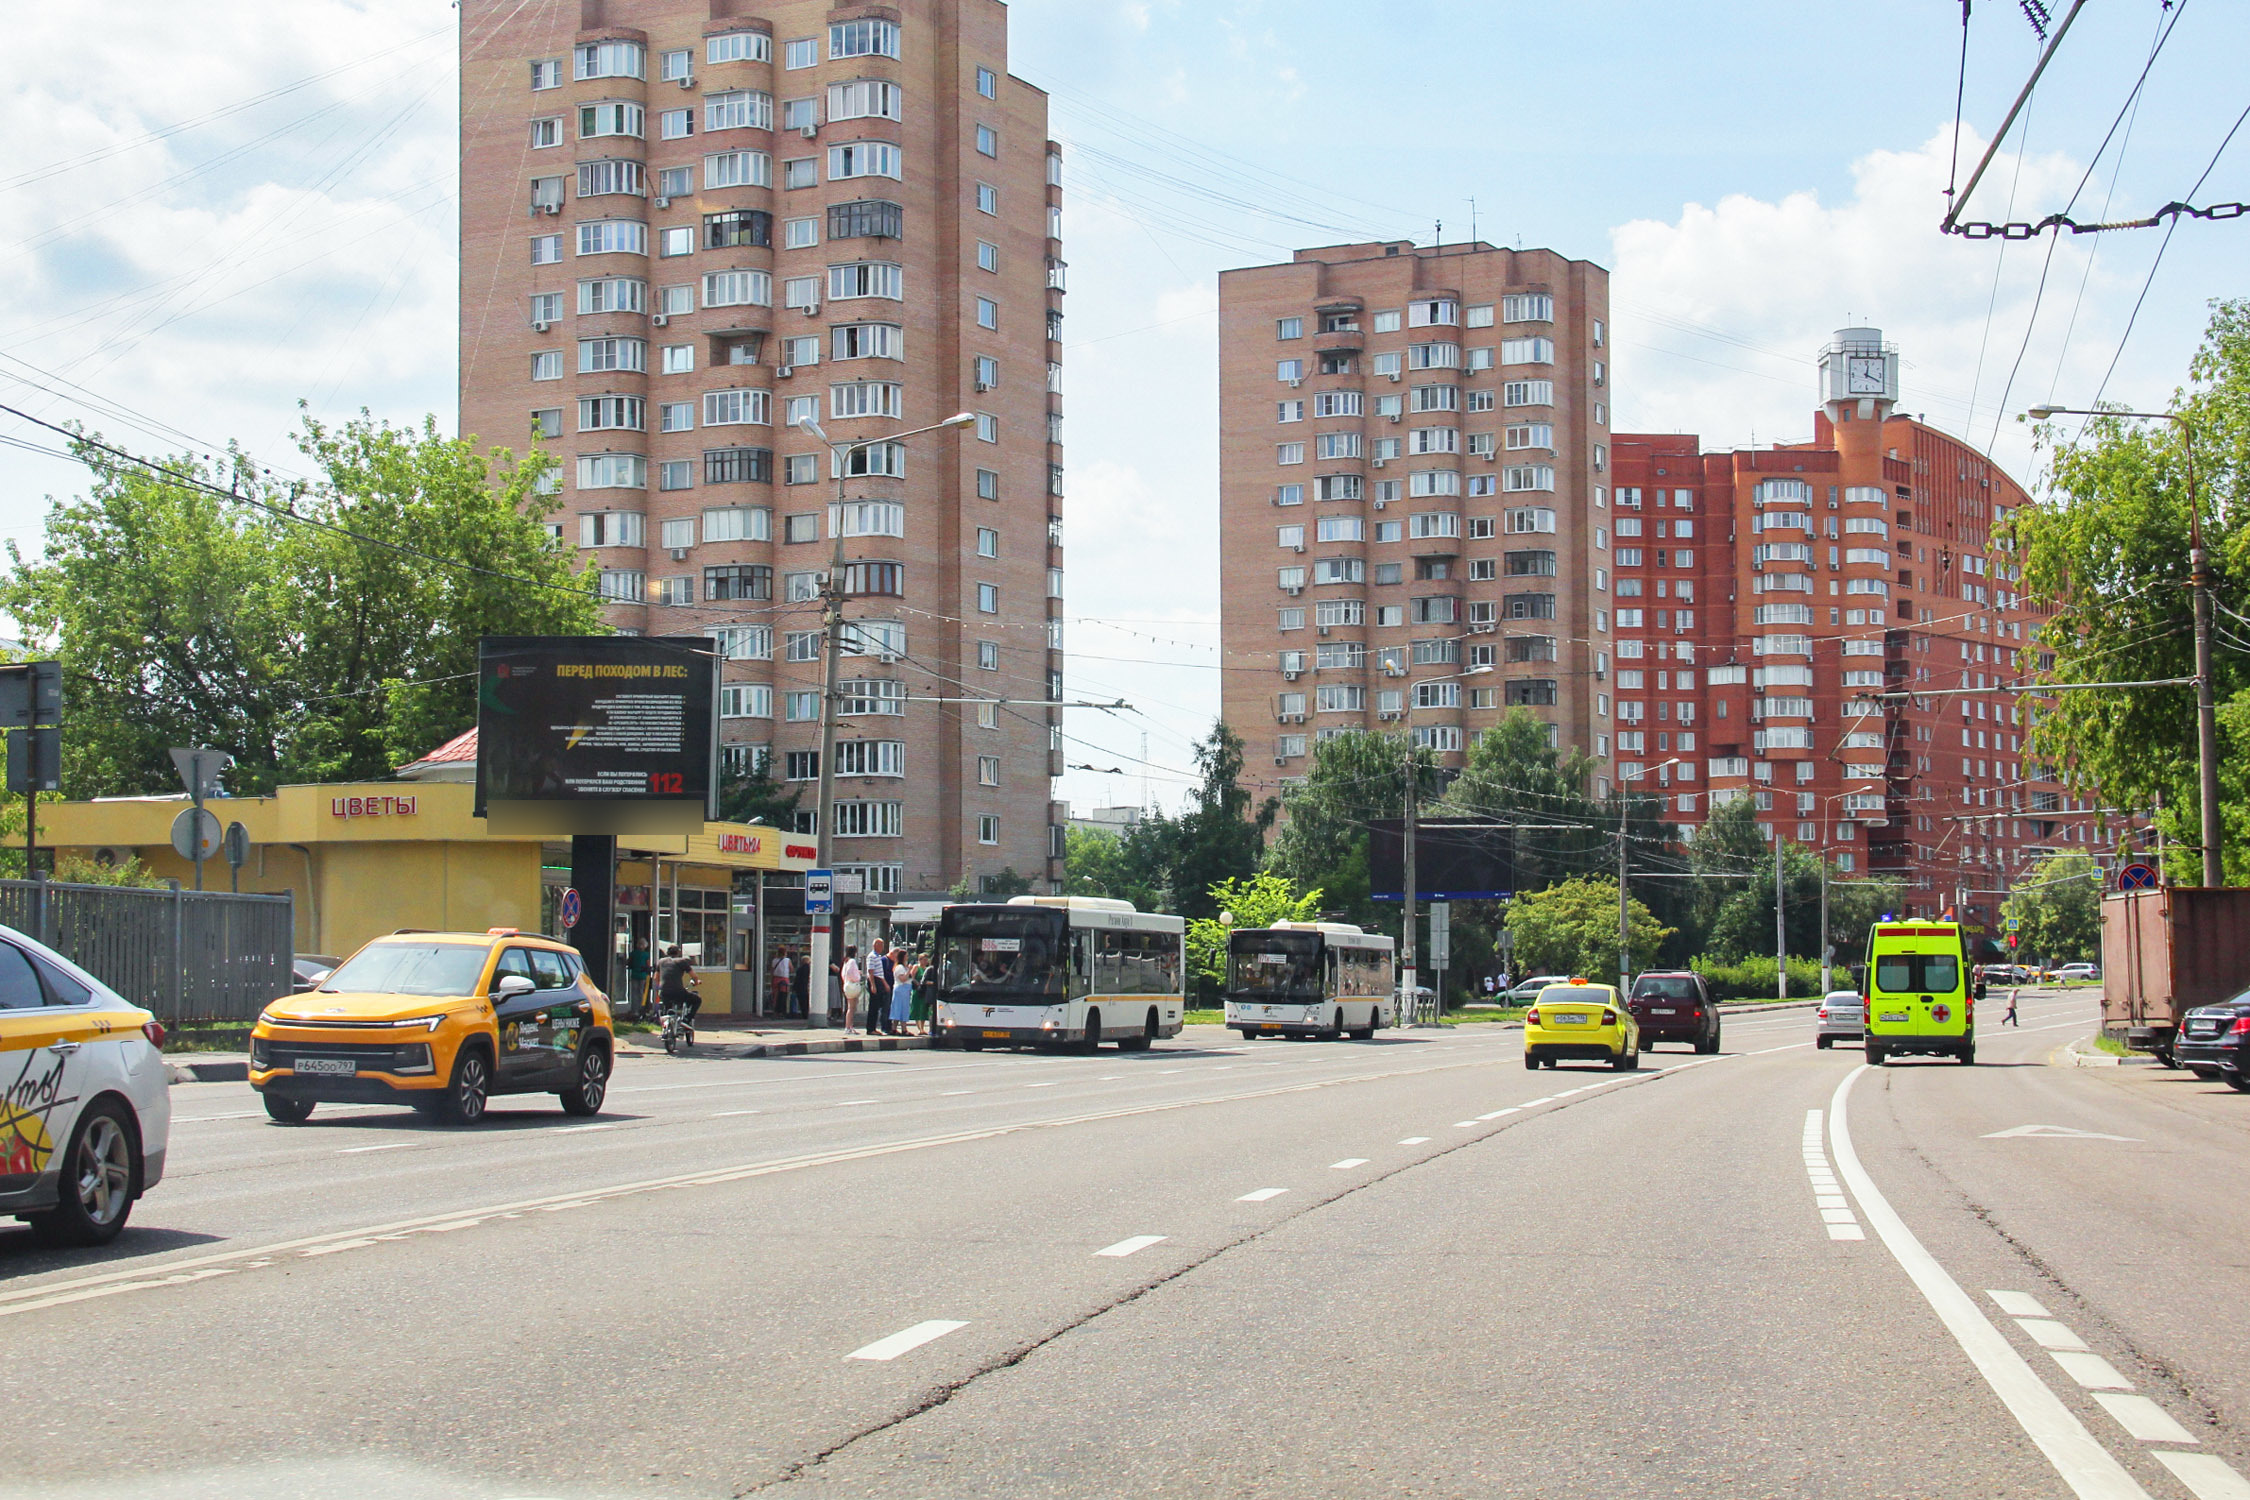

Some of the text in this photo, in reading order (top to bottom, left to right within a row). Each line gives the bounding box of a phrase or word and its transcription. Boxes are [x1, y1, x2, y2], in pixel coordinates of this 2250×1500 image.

[556, 664, 689, 679] ПЕРЕД ПОХОДОМ В ЛЕС:
[649, 773, 683, 793] 112
[331, 796, 417, 820] ЦВЕТЫ
